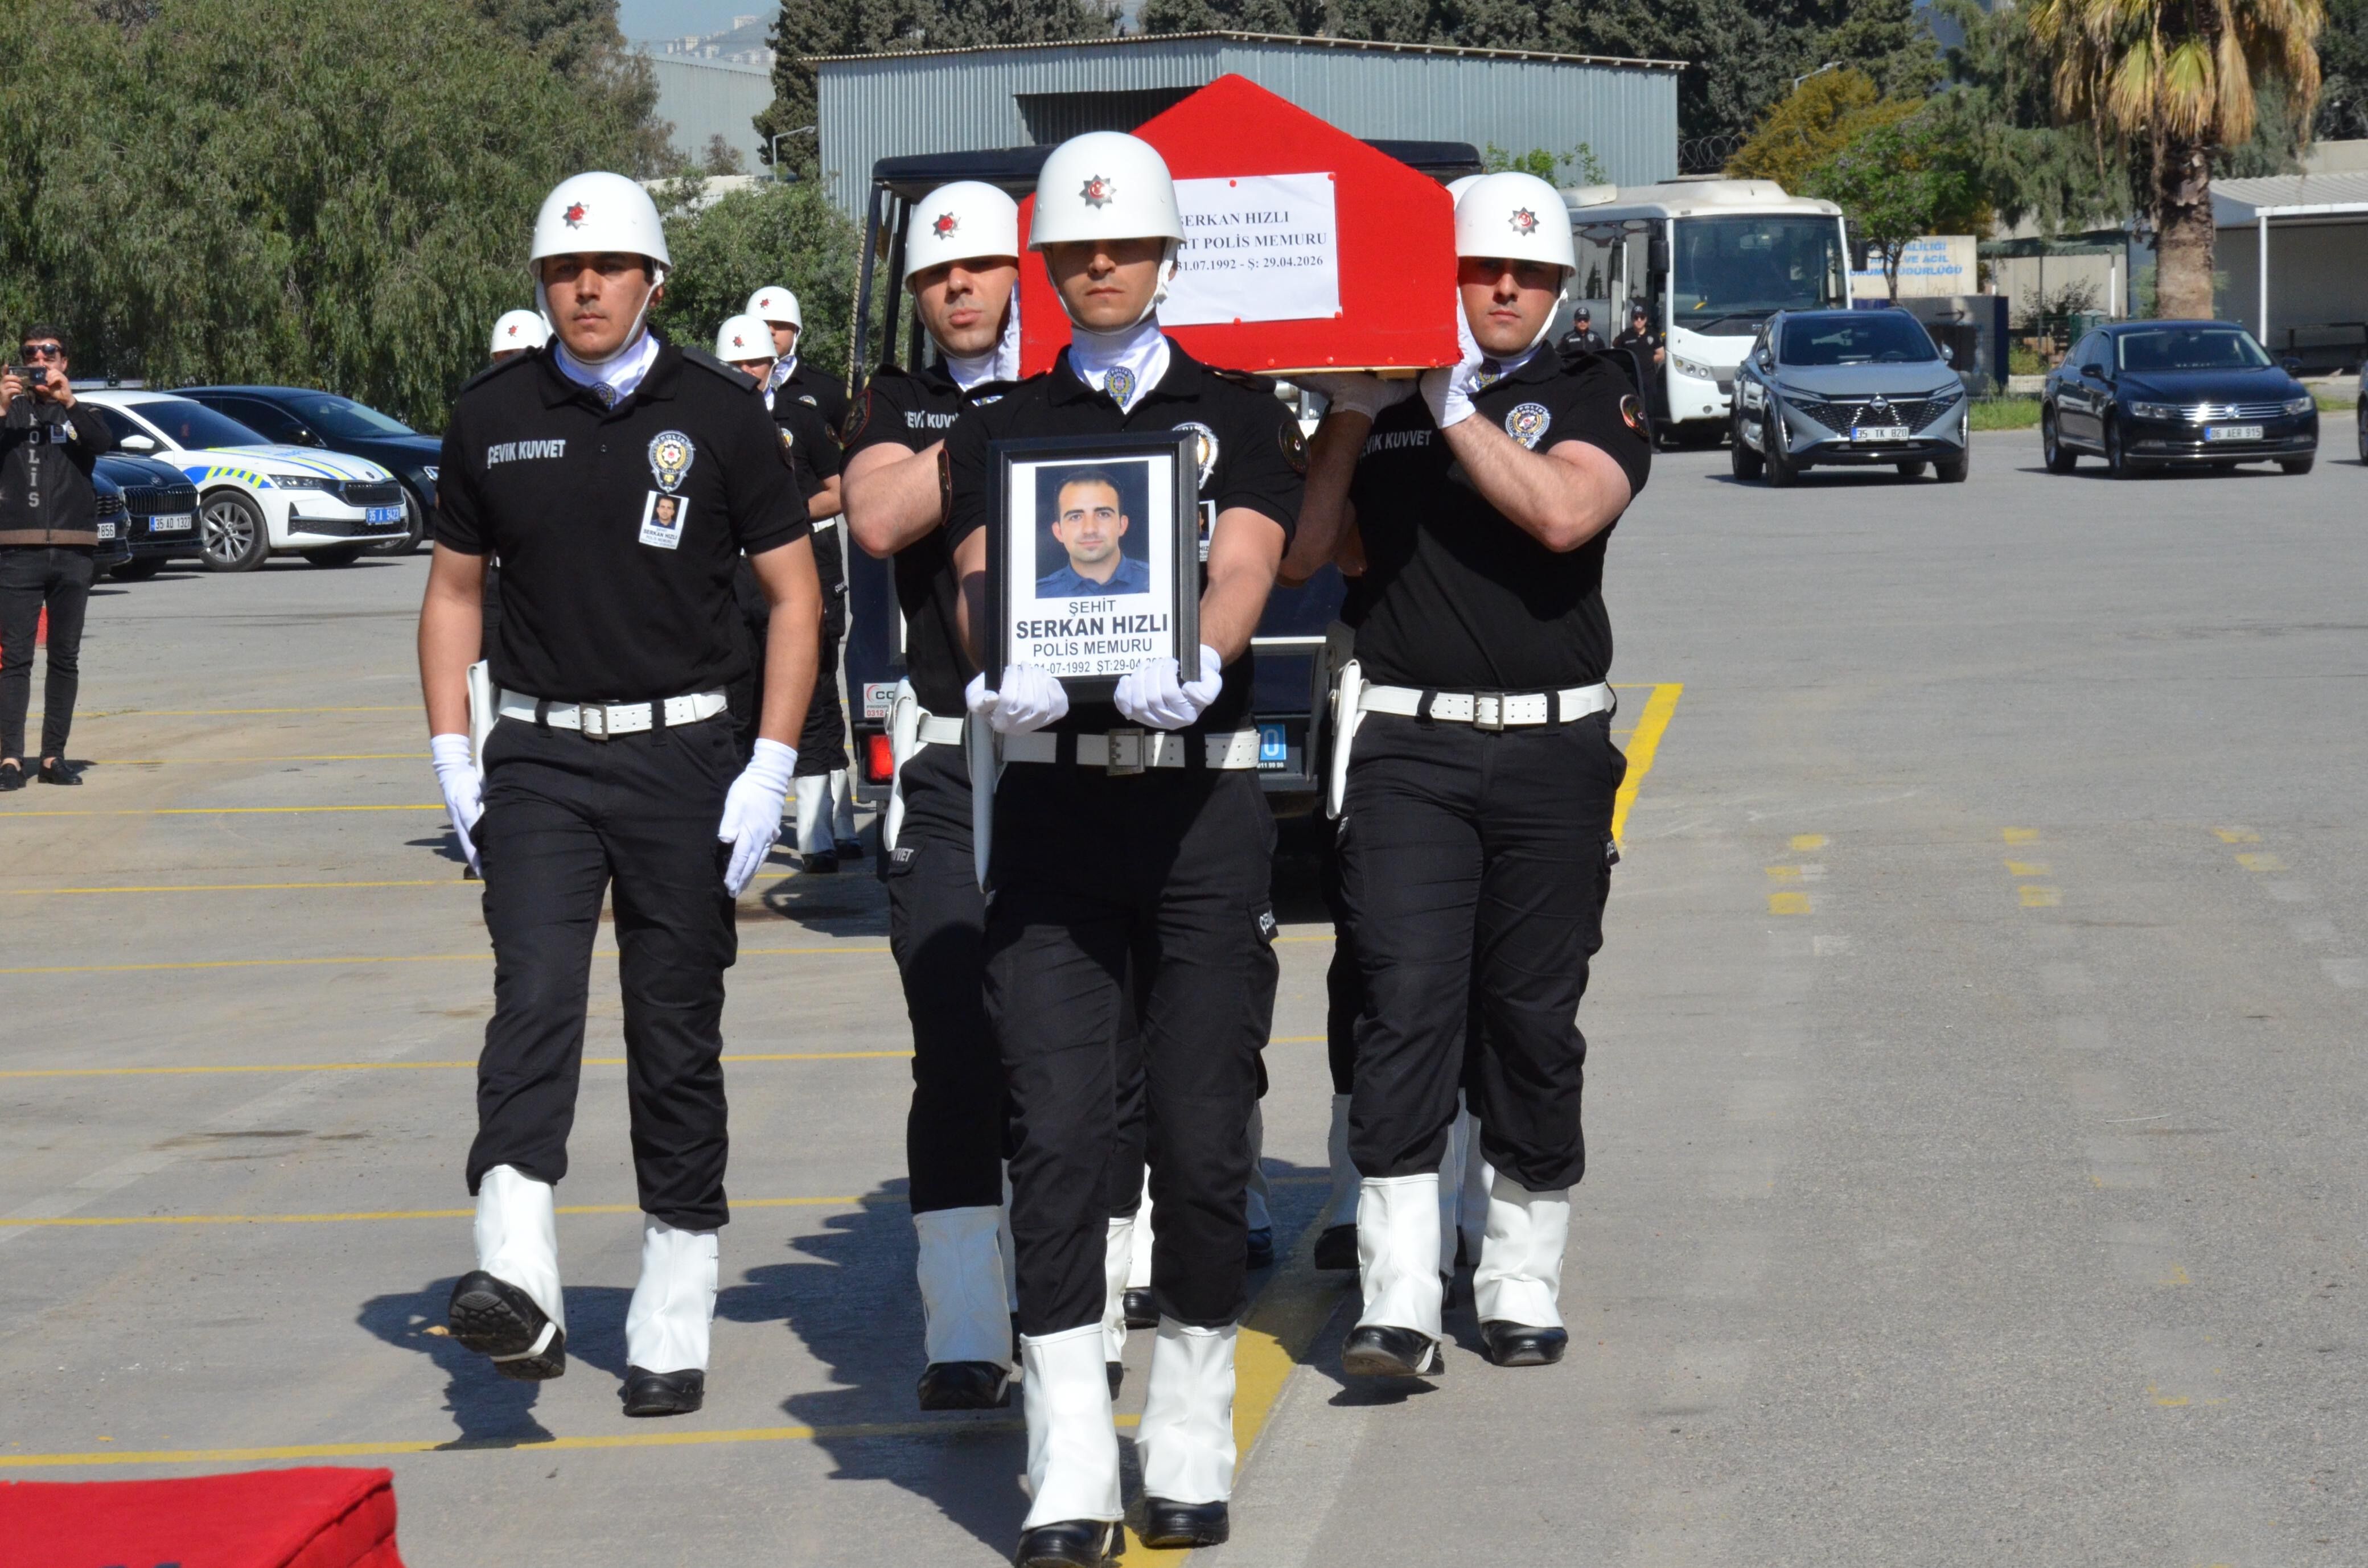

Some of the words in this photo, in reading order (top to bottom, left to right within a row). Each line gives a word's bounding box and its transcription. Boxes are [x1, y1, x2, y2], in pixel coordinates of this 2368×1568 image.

[1245, 211, 1289, 224] HIZLI
[1204, 234, 1250, 249] POLİS
[1254, 233, 1327, 247] MEMURU
[1263, 256, 1323, 269] 29.04.2026
[1384, 429, 1432, 449] KUVVET
[1857, 429, 1867, 438] 35
[1875, 429, 1885, 438] TK
[1891, 428, 1907, 438] 820
[518, 439, 566, 460] KUVVET
[155, 518, 164, 529] 35
[177, 517, 191, 528] 1327
[1069, 598, 1116, 617] ŞEHİT
[1016, 617, 1104, 639] SERKAN
[1112, 613, 1168, 635] HIZLI
[1033, 639, 1079, 657] POLİS
[1084, 638, 1152, 655] MEMURU
